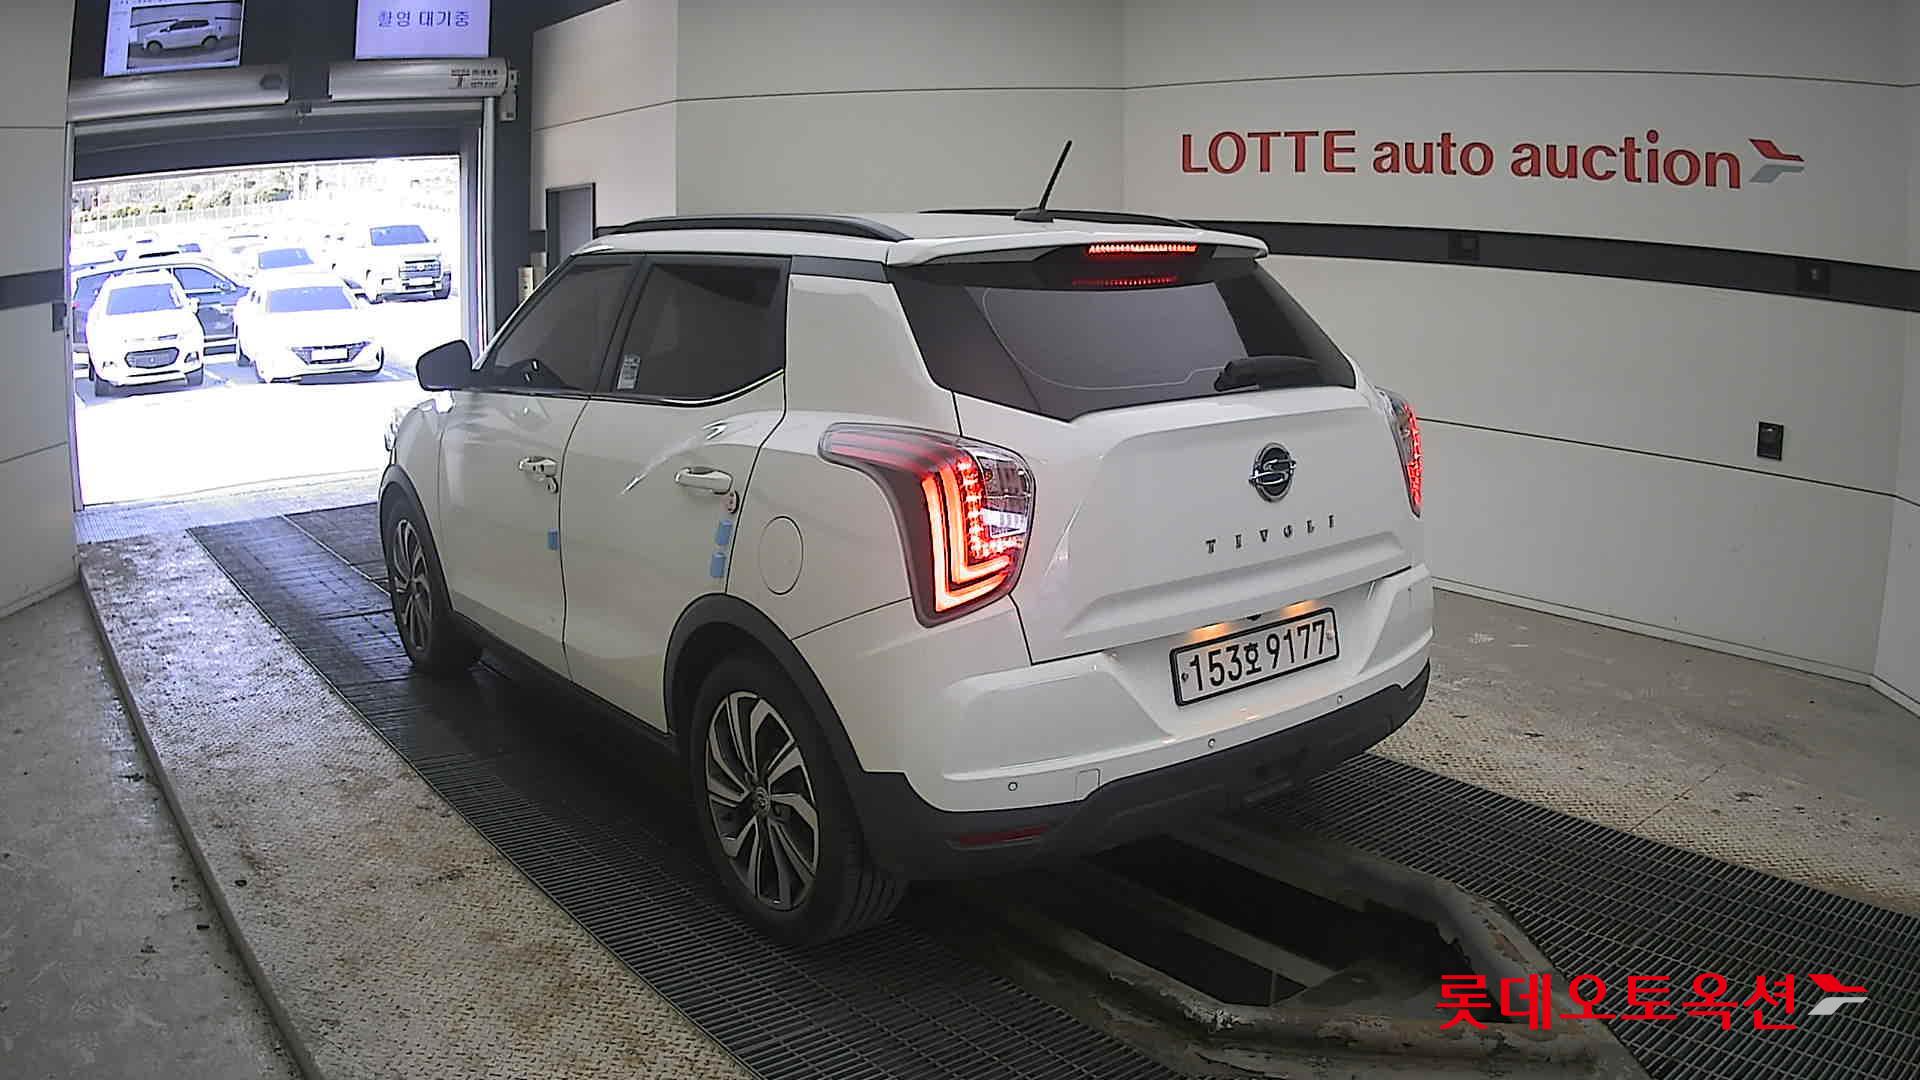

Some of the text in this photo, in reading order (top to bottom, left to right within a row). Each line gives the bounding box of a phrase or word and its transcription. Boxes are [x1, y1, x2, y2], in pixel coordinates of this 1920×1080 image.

[418, 10, 470, 28] 대기중
[1181, 129, 1742, 190] LOTTE auto auction
[1205, 514, 1335, 554] TIVOLI
